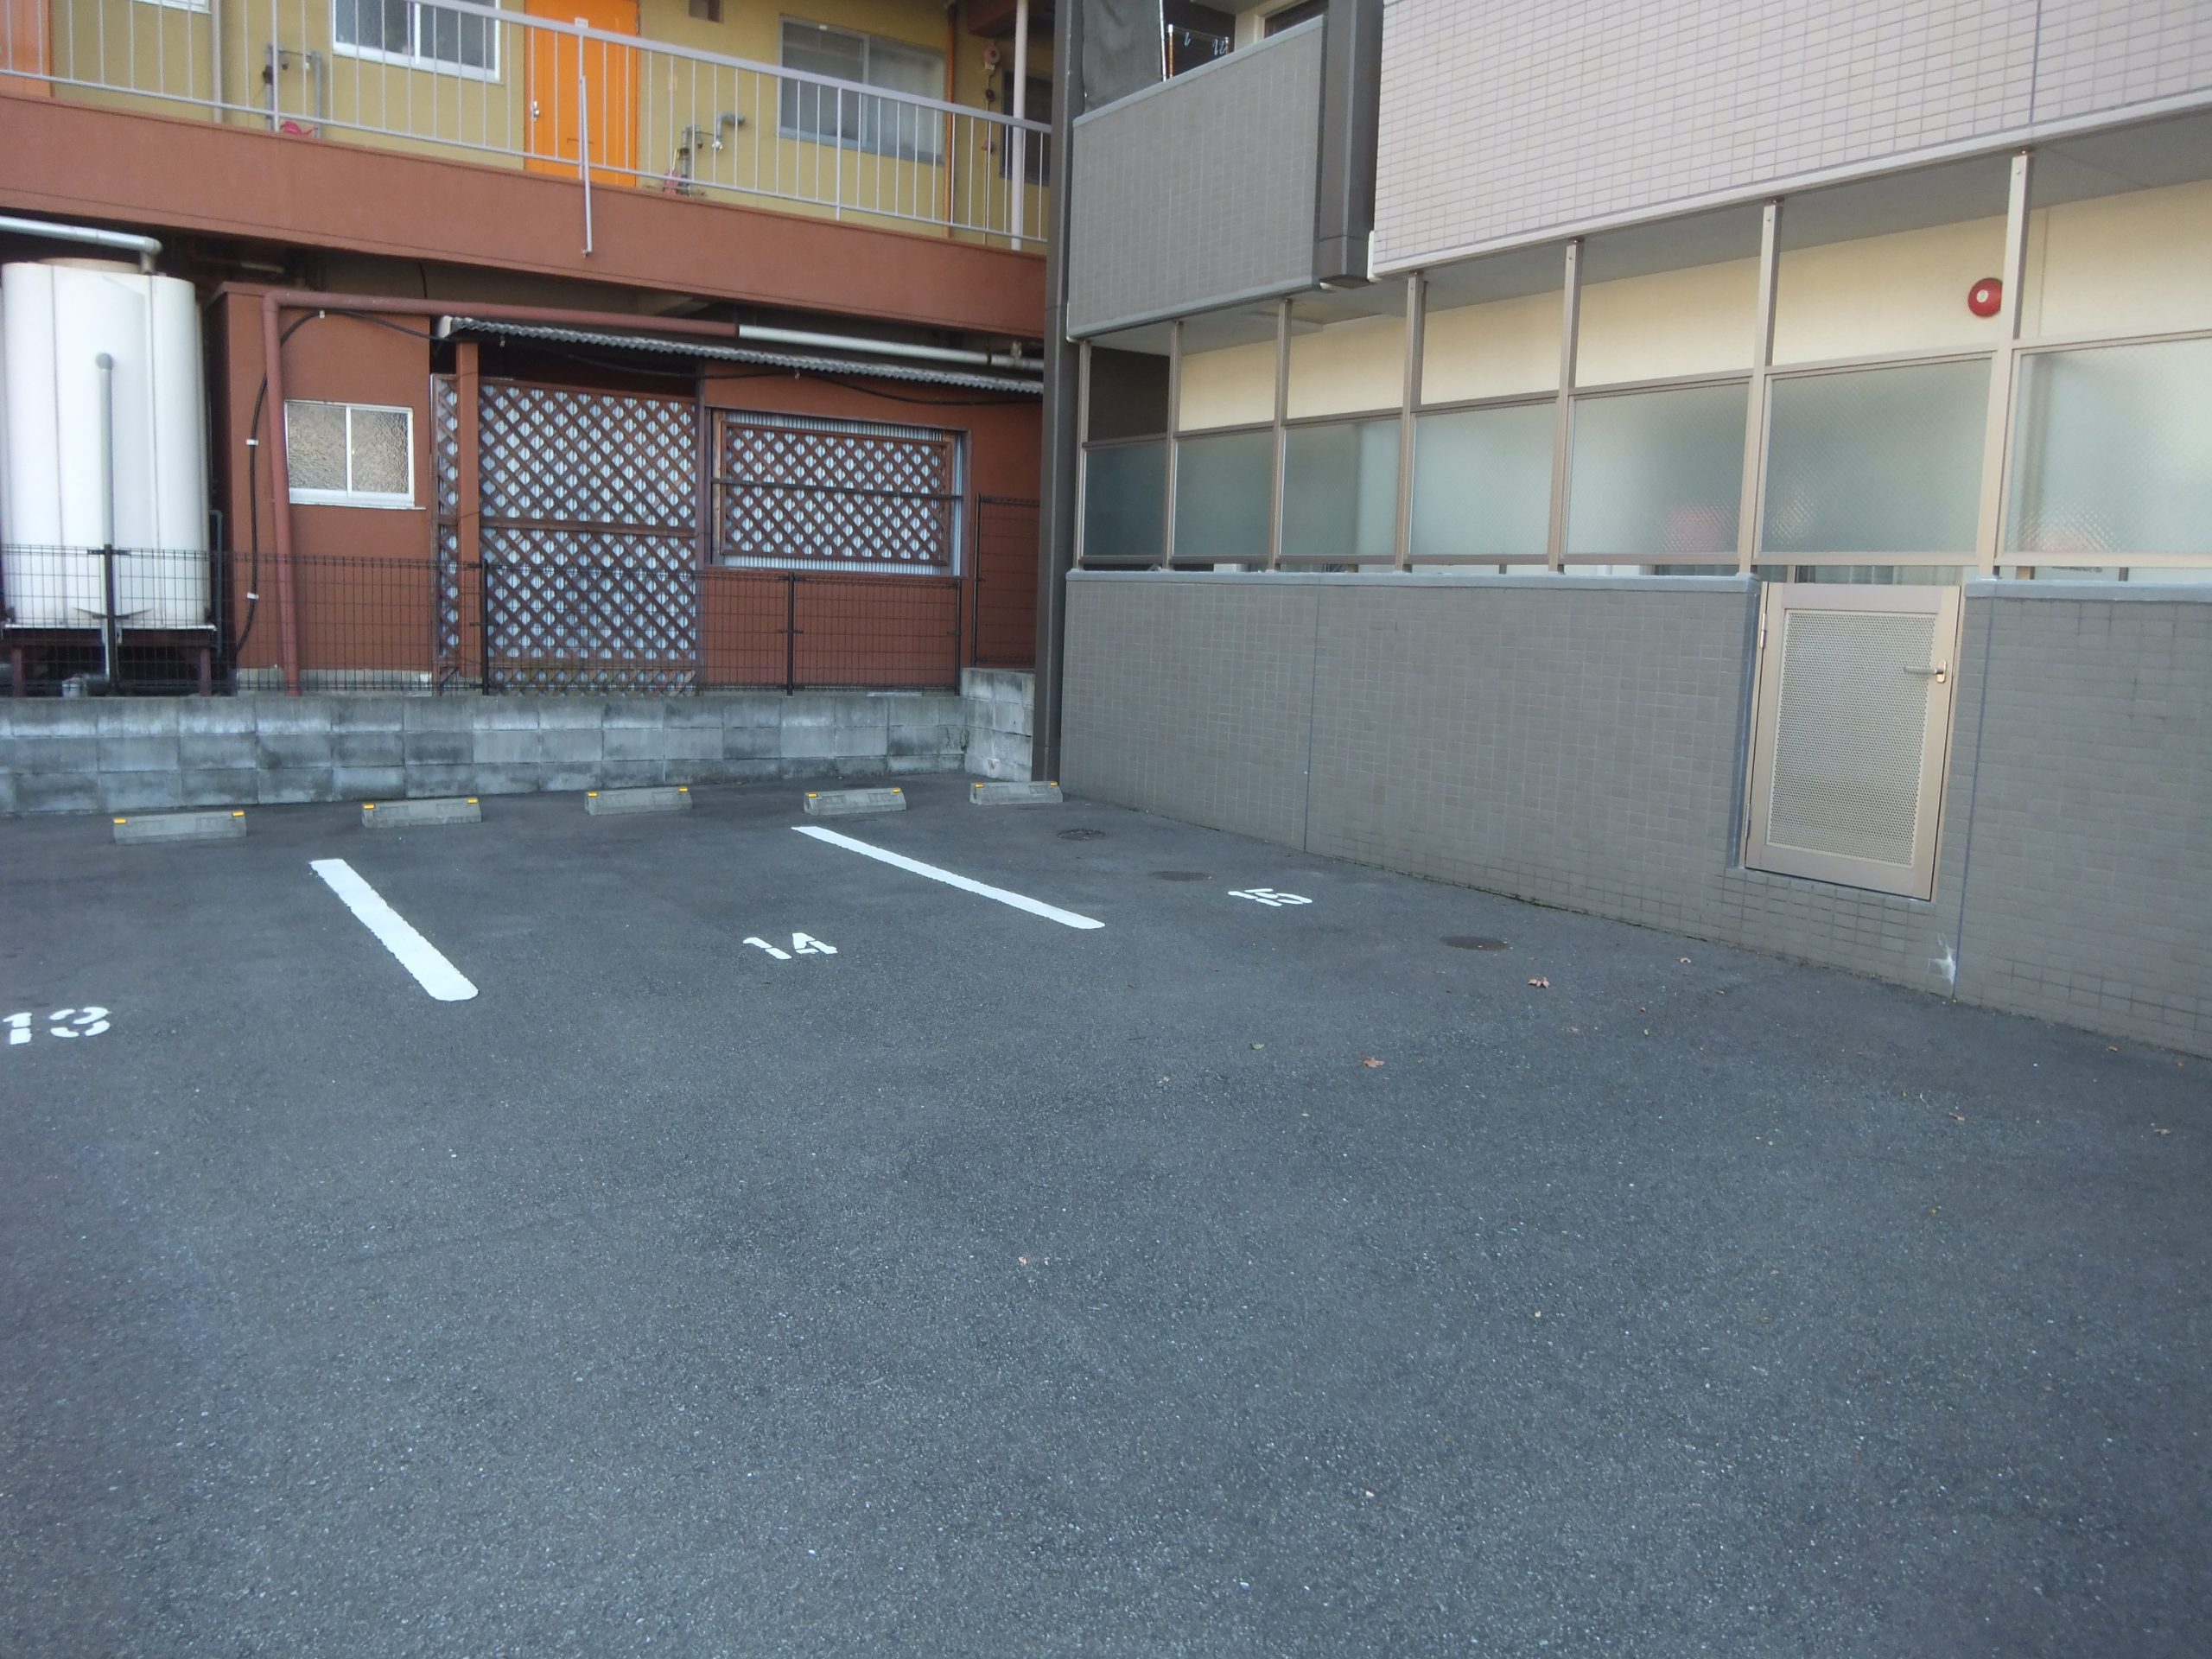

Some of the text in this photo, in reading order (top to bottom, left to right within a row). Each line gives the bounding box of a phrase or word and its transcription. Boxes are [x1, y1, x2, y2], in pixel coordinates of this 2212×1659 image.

[1227, 887, 1313, 907] 15
[742, 932, 839, 960] 14
[3, 1006, 111, 1046] 13
